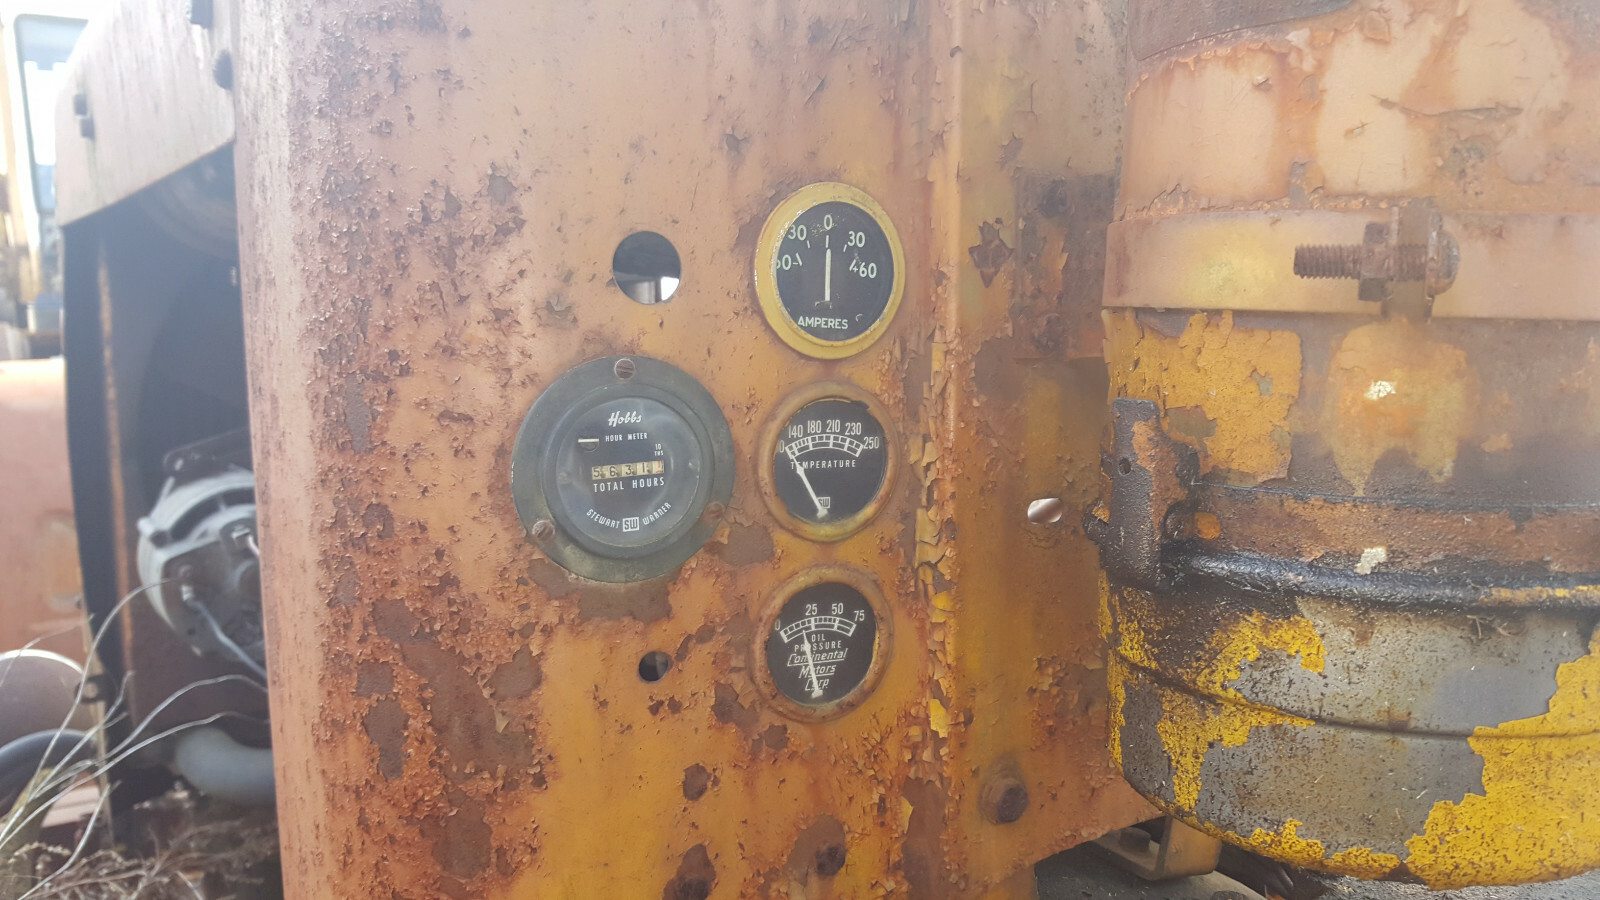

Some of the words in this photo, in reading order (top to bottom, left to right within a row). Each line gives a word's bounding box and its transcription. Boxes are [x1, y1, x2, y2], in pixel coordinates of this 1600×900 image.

[788, 224, 807, 241] 30
[823, 214, 833, 231] 0
[847, 231, 866, 248] 30
[797, 316, 848, 330] AMPERES
[608, 411, 642, 427] Hobbs
[605, 434, 623, 442] HOUR
[628, 432, 648, 441] METER
[788, 424, 804, 438] 140
[807, 420, 822, 434] 180
[826, 419, 841, 433] 210
[845, 422, 862, 436] 230
[863, 436, 880, 450] 250
[593, 481, 624, 492] TOTAL
[632, 477, 664, 489] HOURS
[586, 508, 620, 529] STEWART
[623, 517, 639, 532] SW
[642, 502, 672, 525] WARNER
[805, 603, 818, 616] 25
[831, 602, 844, 615] 50
[853, 610, 865, 622] 75
[811, 633, 826, 642] OIL
[794, 640, 842, 652] PRSSURE
[787, 647, 848, 667] Coninental
[798, 664, 837, 679] Mtors
[804, 678, 830, 691] Crp.
